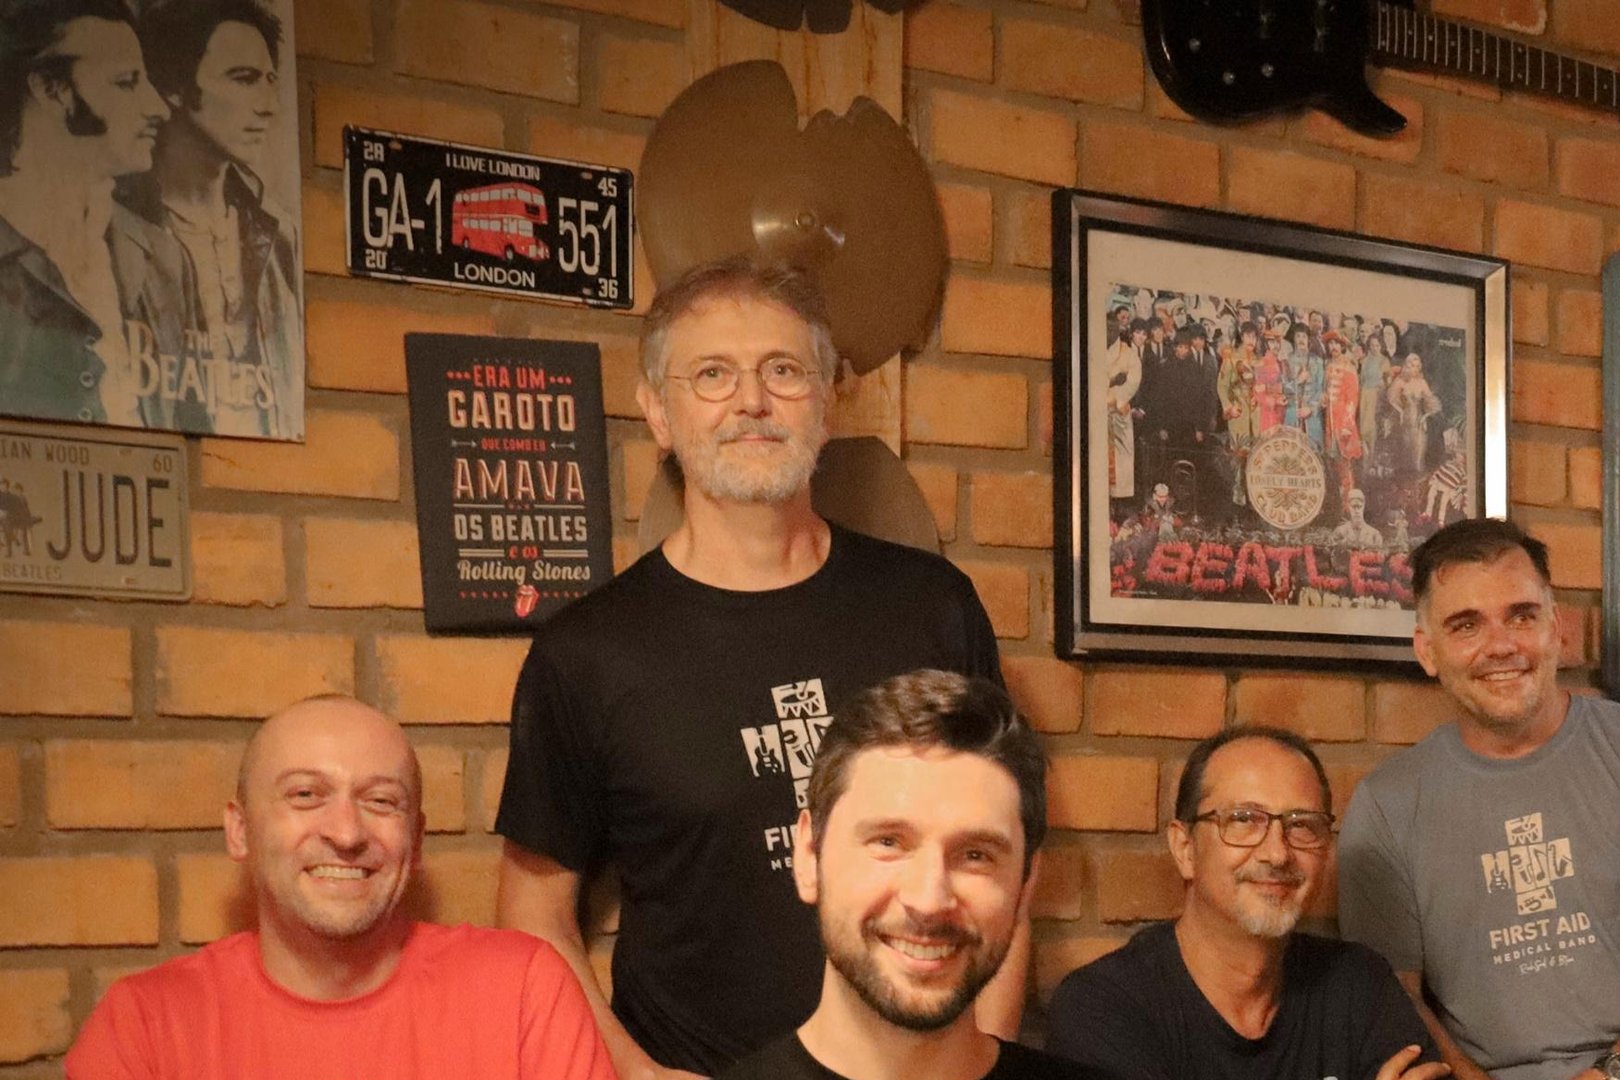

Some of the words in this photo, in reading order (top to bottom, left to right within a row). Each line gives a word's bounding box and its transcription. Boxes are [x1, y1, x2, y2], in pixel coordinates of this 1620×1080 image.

[446, 153, 450, 167] I
[452, 154, 486, 173] LOVE
[489, 158, 540, 181] LONDON
[597, 177, 617, 198] 45
[558, 197, 617, 277] 551
[365, 249, 387, 270] 20
[454, 262, 536, 288] LONDON
[598, 277, 618, 299] 36
[473, 365, 510, 388] ERA
[516, 368, 545, 390] UM
[447, 389, 575, 432] GAROTO
[46, 443, 89, 465] WOOD
[152, 454, 172, 473] 60
[453, 457, 585, 502] AMAVA
[47, 470, 172, 567] JUDE
[453, 514, 483, 540] OS
[491, 515, 587, 542] BEATLES
[457, 559, 526, 585] Rolling
[532, 561, 590, 581] Stones
[1146, 541, 1415, 601] BEATLES
[1489, 918, 1550, 949] FIRST
[1556, 911, 1591, 935] AID
[1493, 942, 1551, 965] MEDICAL
[1559, 934, 1596, 949] BAND
